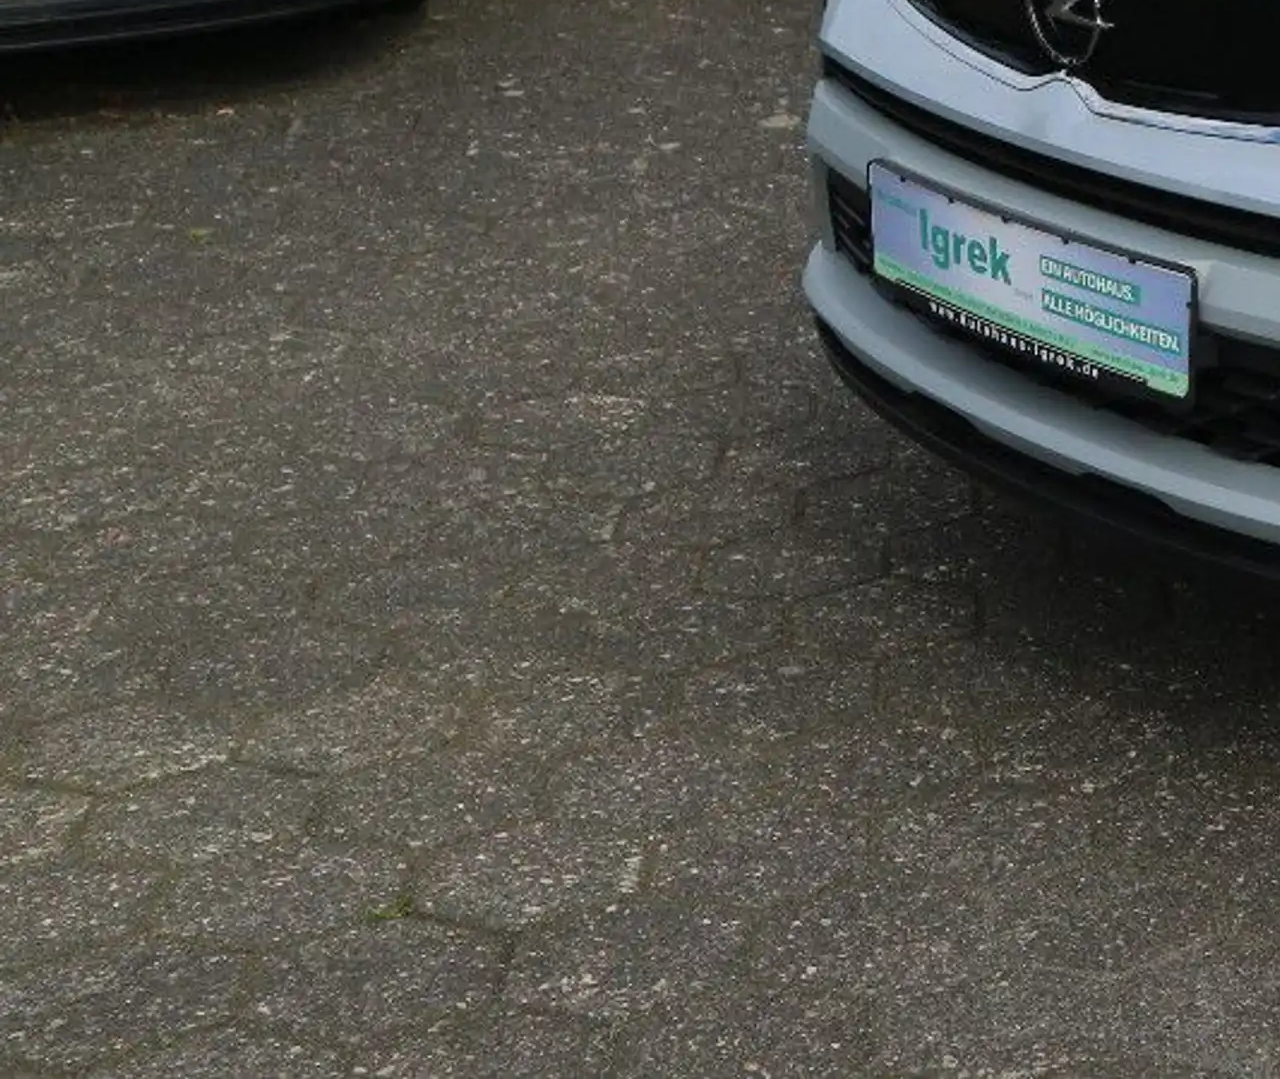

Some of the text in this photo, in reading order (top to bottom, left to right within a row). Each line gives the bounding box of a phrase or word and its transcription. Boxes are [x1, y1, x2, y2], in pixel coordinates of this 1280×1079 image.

[917, 207, 1012, 286] Igrek
[1042, 257, 1062, 276] EIN
[1044, 294, 1073, 317] ALLE
